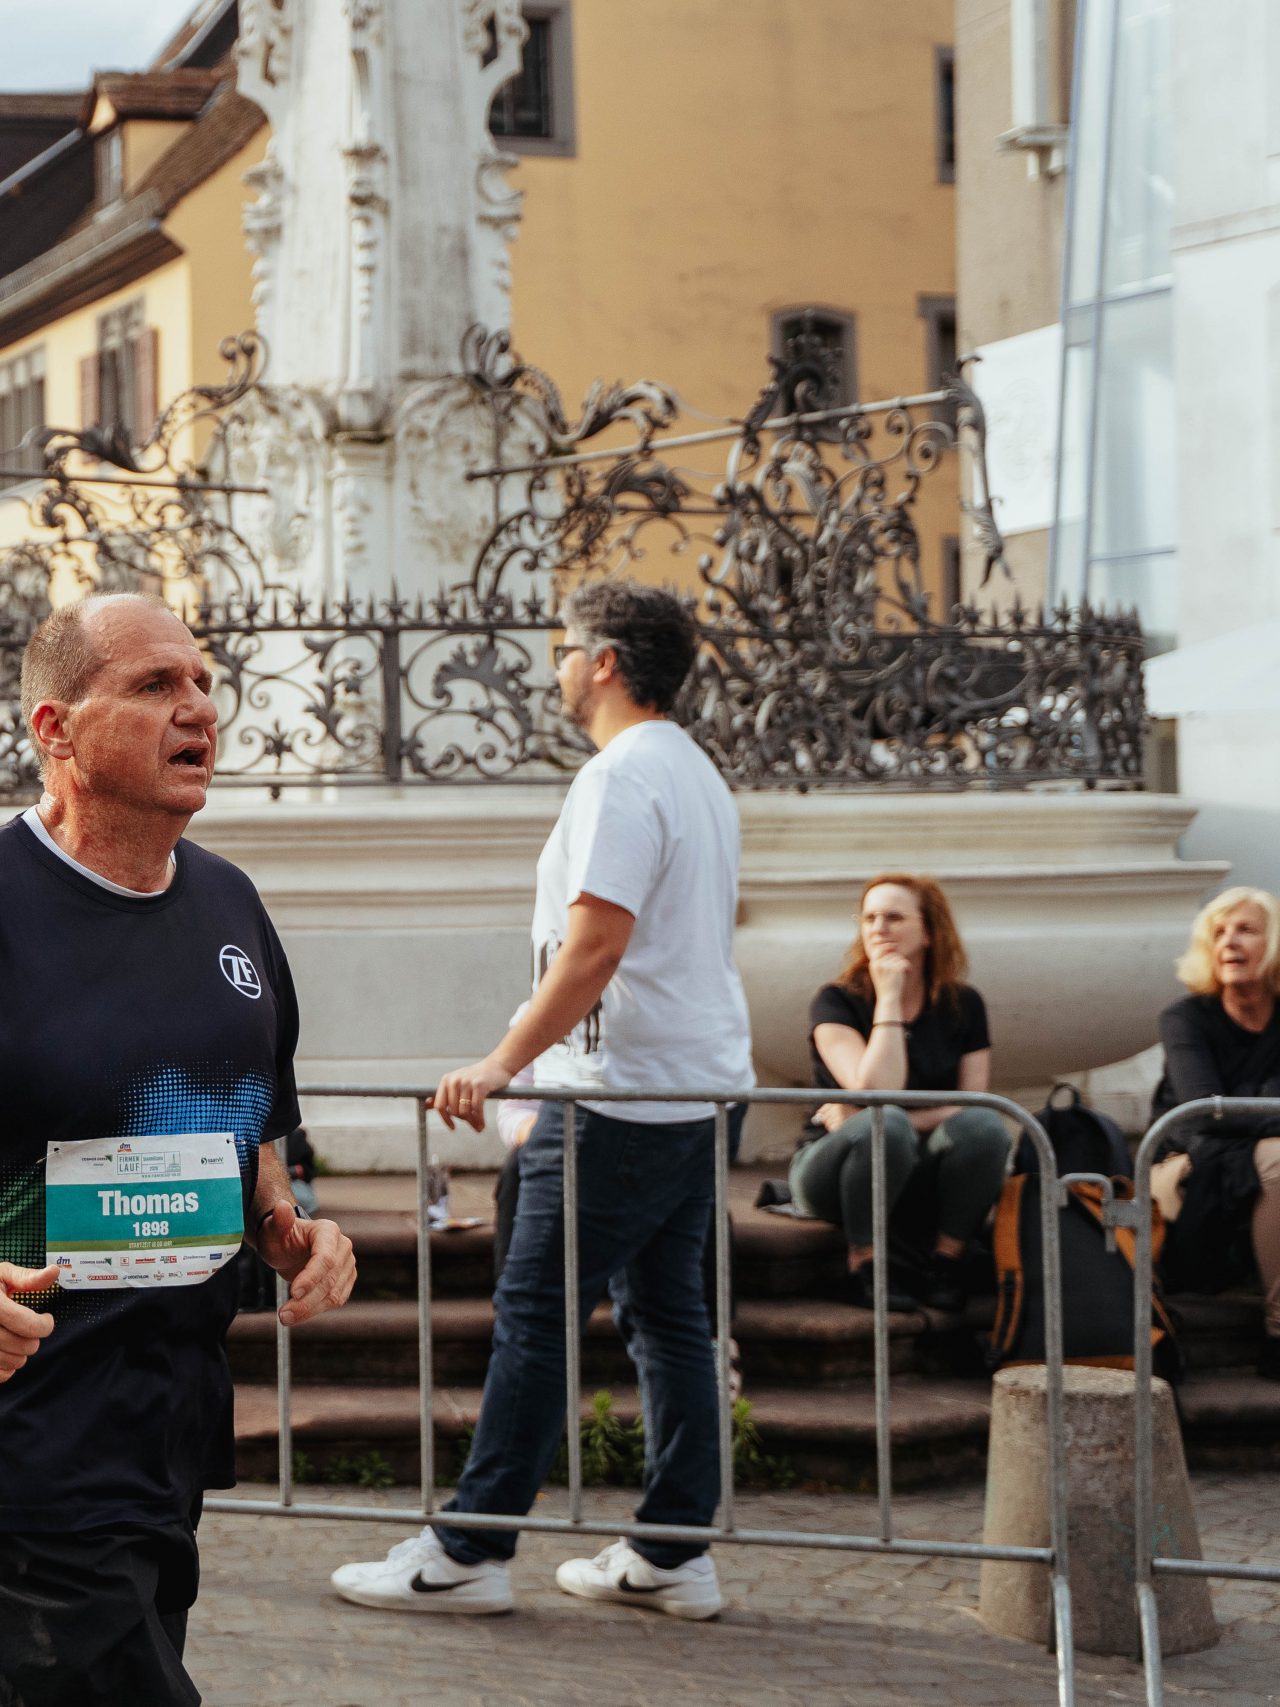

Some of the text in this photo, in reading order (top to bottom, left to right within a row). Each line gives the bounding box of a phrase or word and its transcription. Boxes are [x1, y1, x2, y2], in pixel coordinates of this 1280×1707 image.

[219, 949, 261, 994] ZF
[119, 1155, 140, 1163] FIRMEN
[119, 1162, 139, 1172] LAUF
[97, 1190, 200, 1217] Thomas
[132, 1220, 170, 1237] 1898
[56, 1256, 71, 1265] dm
